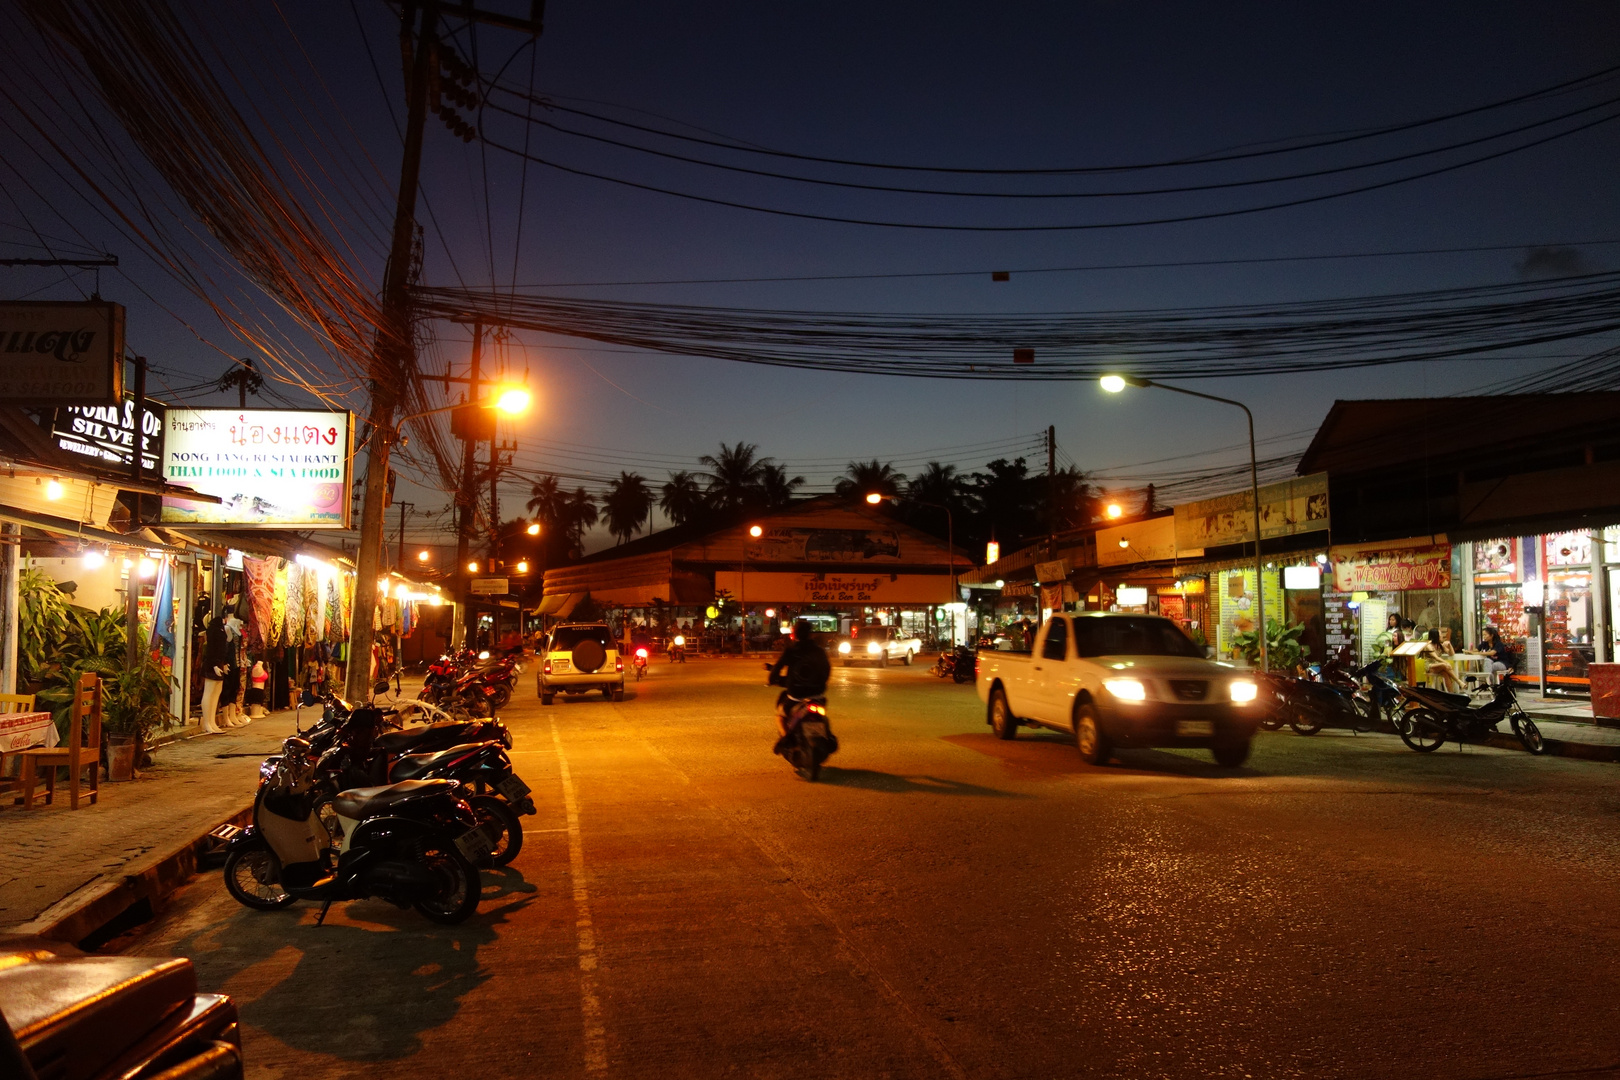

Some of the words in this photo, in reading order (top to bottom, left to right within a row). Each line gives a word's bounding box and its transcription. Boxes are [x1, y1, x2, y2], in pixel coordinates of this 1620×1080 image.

[171, 416, 216, 432] ร้านอาหาร
[171, 452, 209, 462] NONG
[216, 453, 250, 463] TANG
[253, 454, 339, 464] RESTAURANT
[168, 465, 204, 477] THAI
[208, 466, 248, 478] FOOD
[812, 591, 835, 601] Beck's
[838, 591, 854, 601] Beer
[857, 591, 871, 601] Bar
